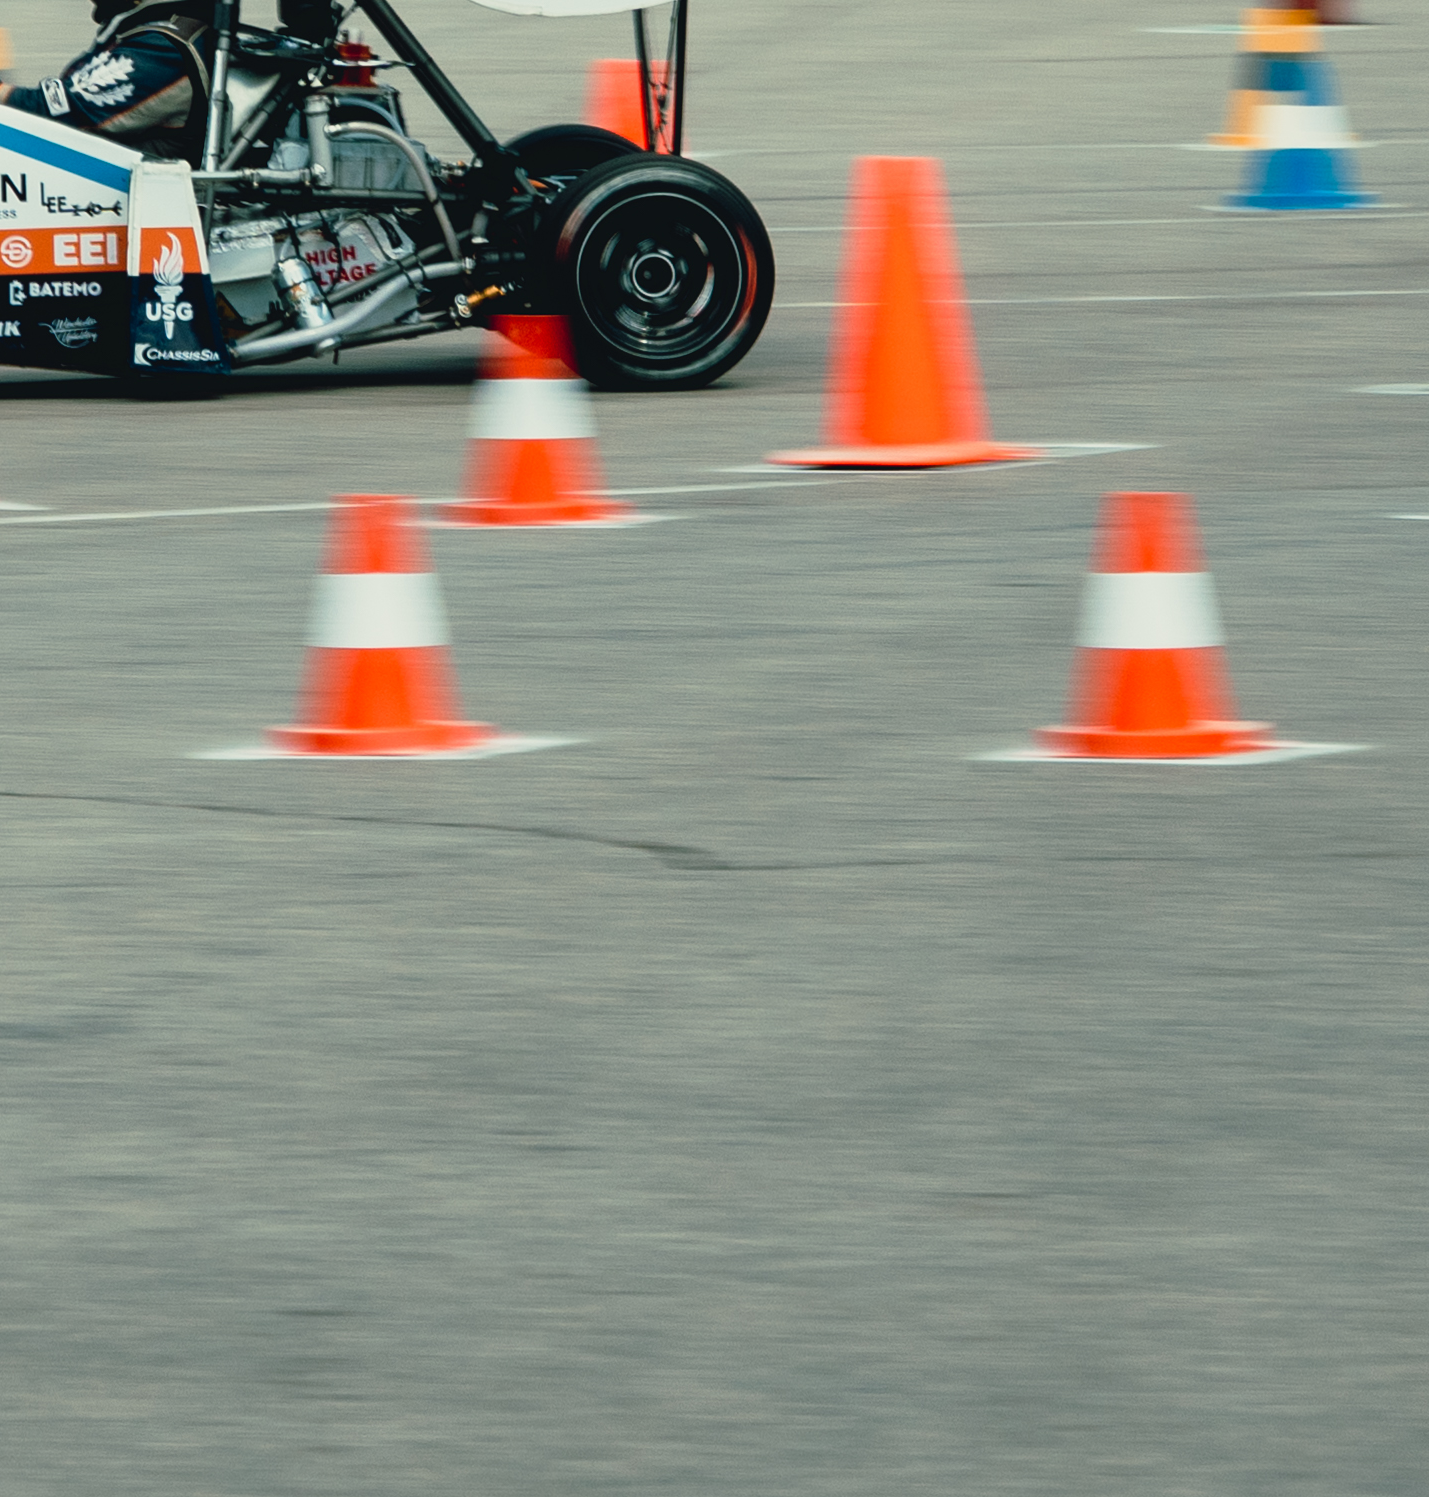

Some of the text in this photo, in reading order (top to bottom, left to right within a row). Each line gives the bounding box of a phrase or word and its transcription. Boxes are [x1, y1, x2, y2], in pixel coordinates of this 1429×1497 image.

[53, 233, 119, 266] EEI
[305, 245, 357, 266] HIGH
[316, 263, 377, 286] LTAGE
[29, 281, 102, 297] BATEMO
[146, 301, 194, 322] USG
